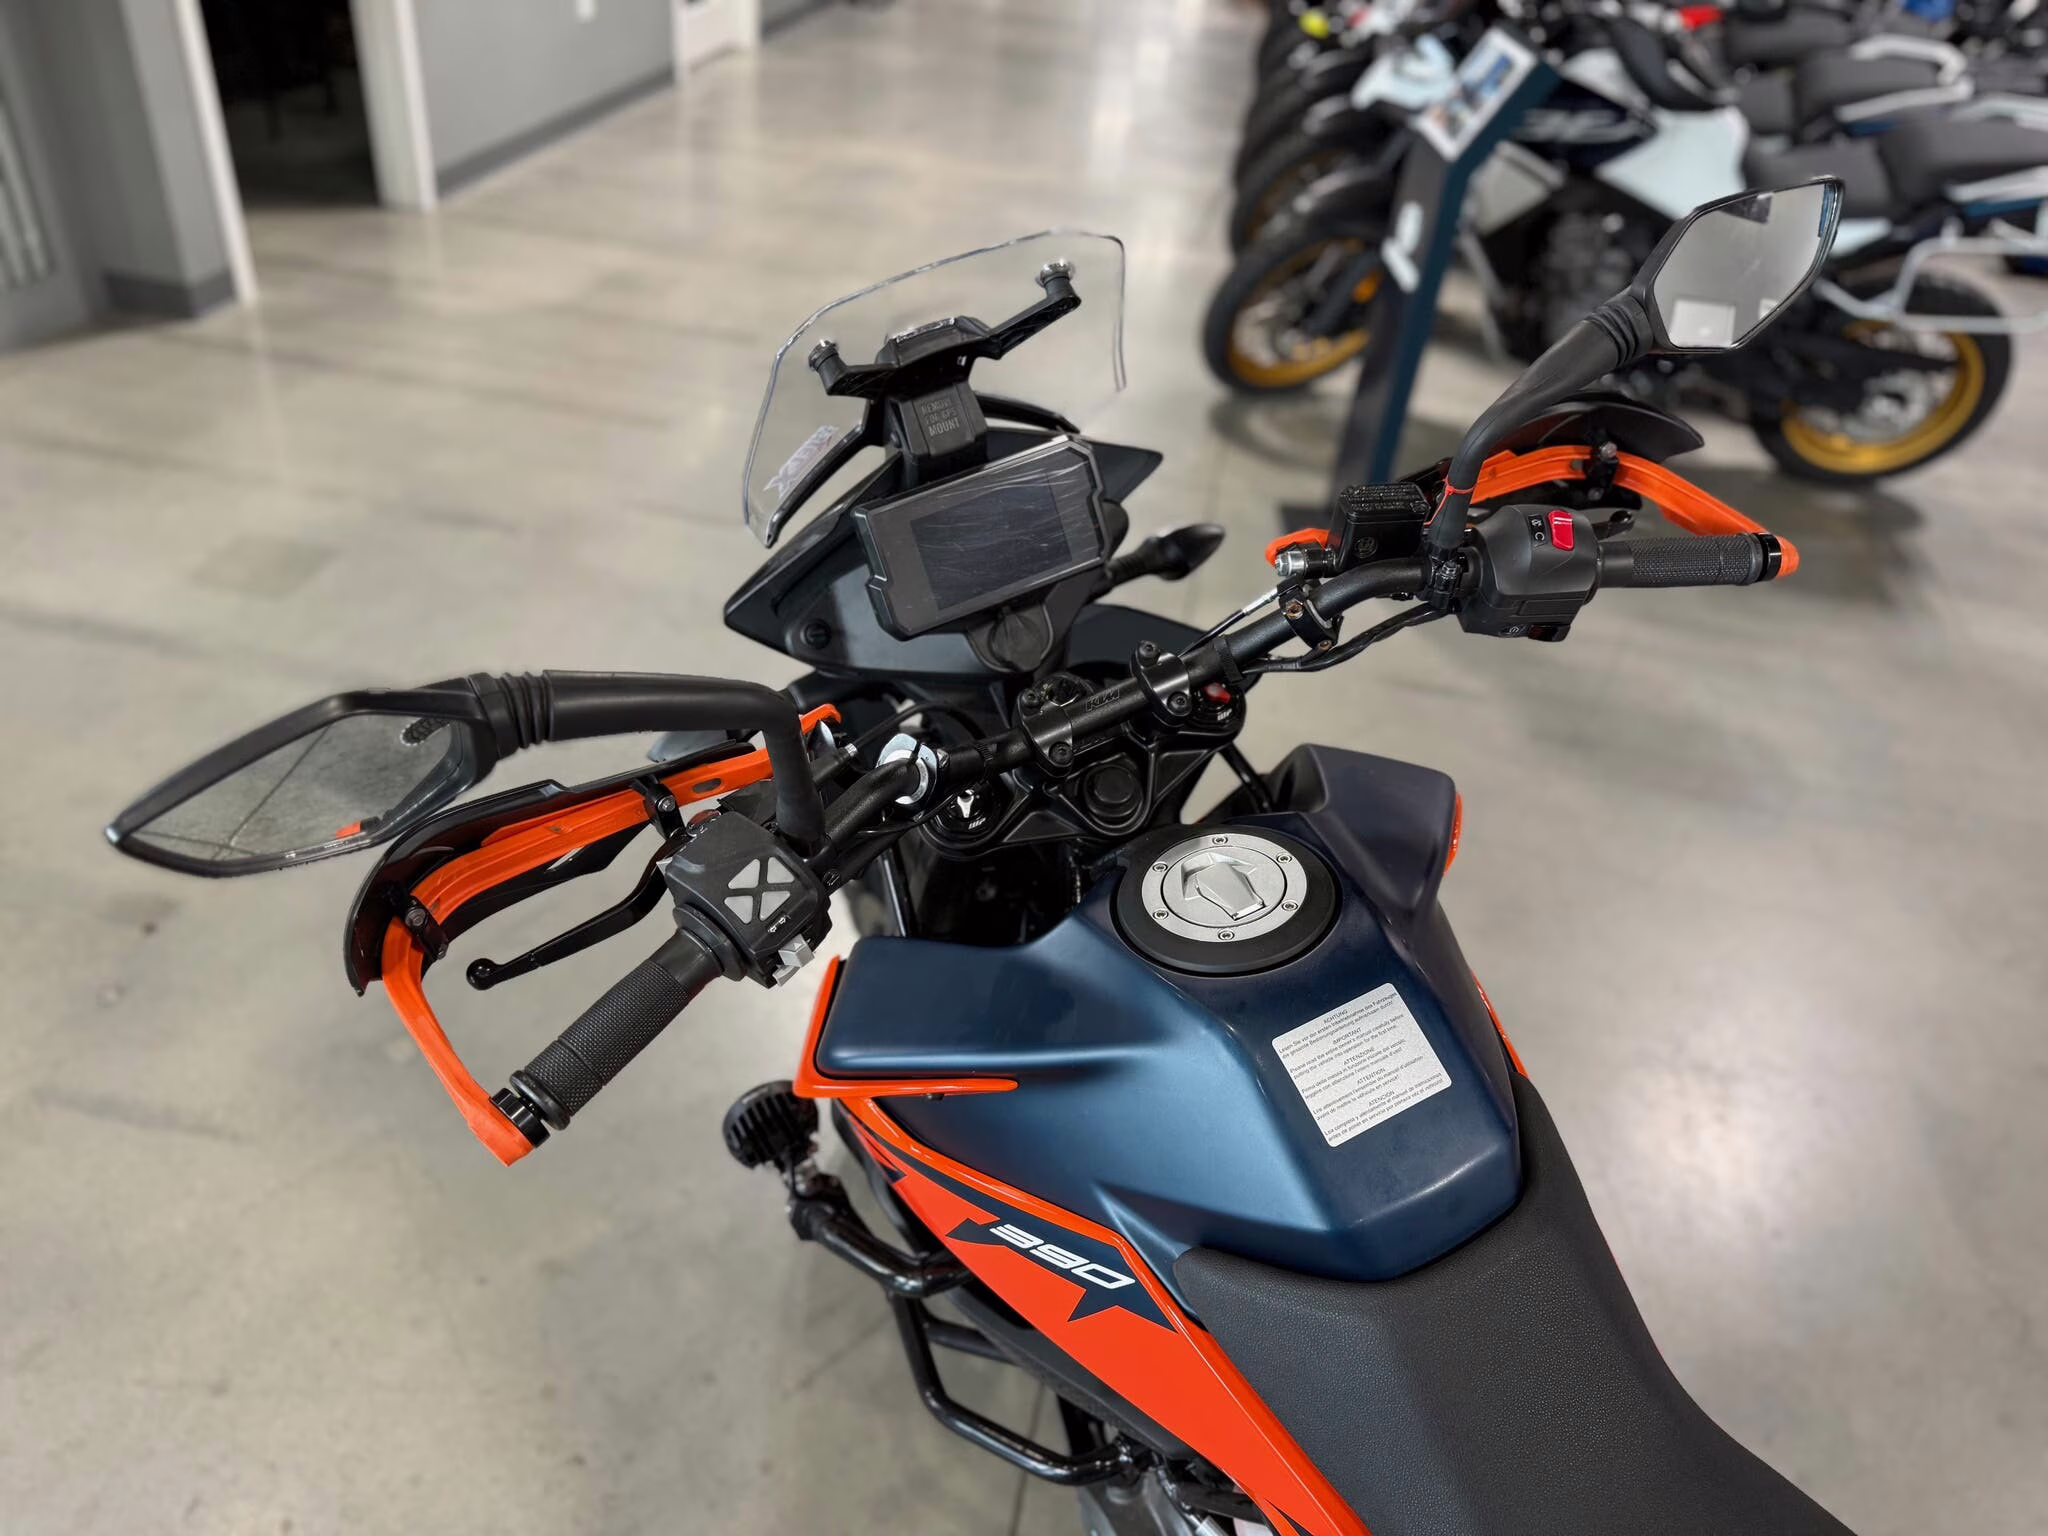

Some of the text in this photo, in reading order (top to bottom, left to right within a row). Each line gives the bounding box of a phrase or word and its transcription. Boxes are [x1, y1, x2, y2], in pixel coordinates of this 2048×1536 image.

[928, 418, 960, 437] MOUNT
[1086, 687, 1120, 712] KTM
[989, 1223, 1136, 1290] 390
